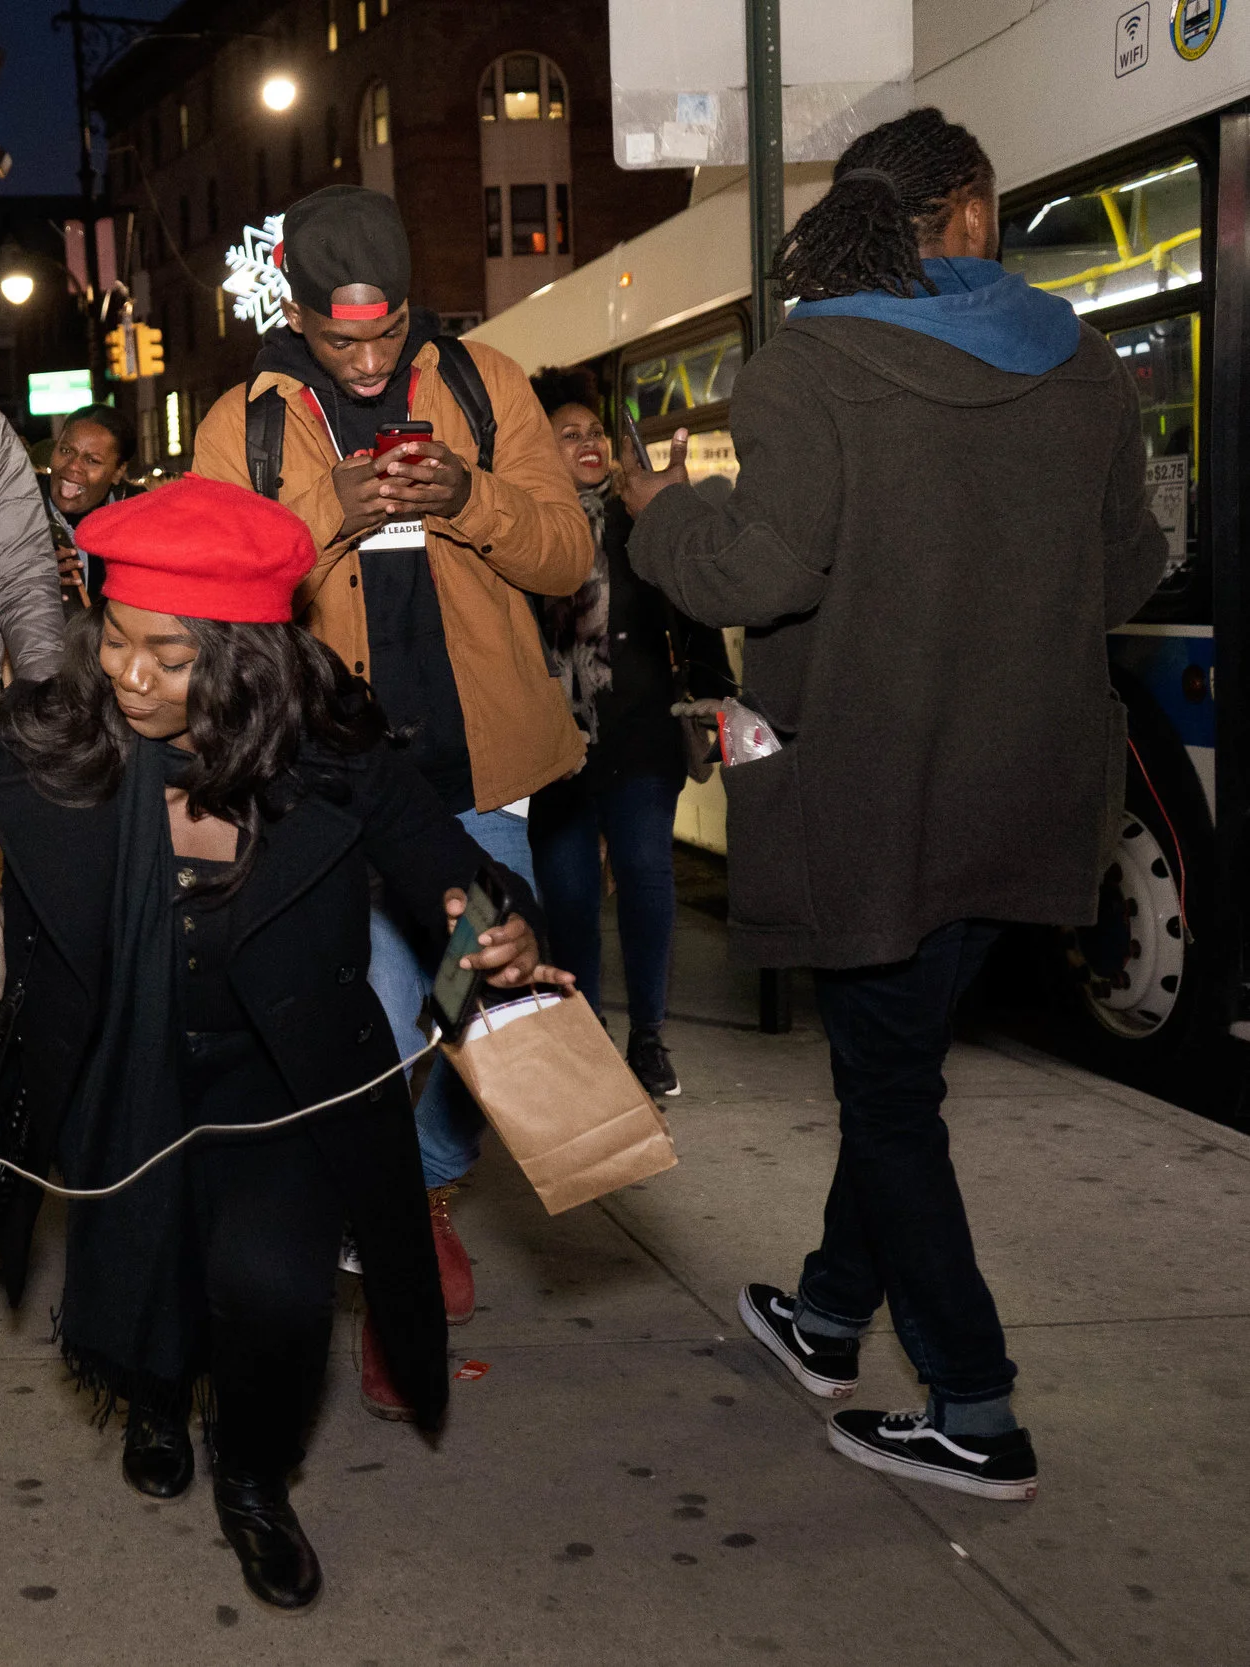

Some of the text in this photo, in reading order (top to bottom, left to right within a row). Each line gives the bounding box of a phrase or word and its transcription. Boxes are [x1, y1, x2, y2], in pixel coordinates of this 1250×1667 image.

[1119, 44, 1143, 69] WIFI
[1154, 463, 1184, 481] $2.75
[388, 525, 424, 534] LEADER
